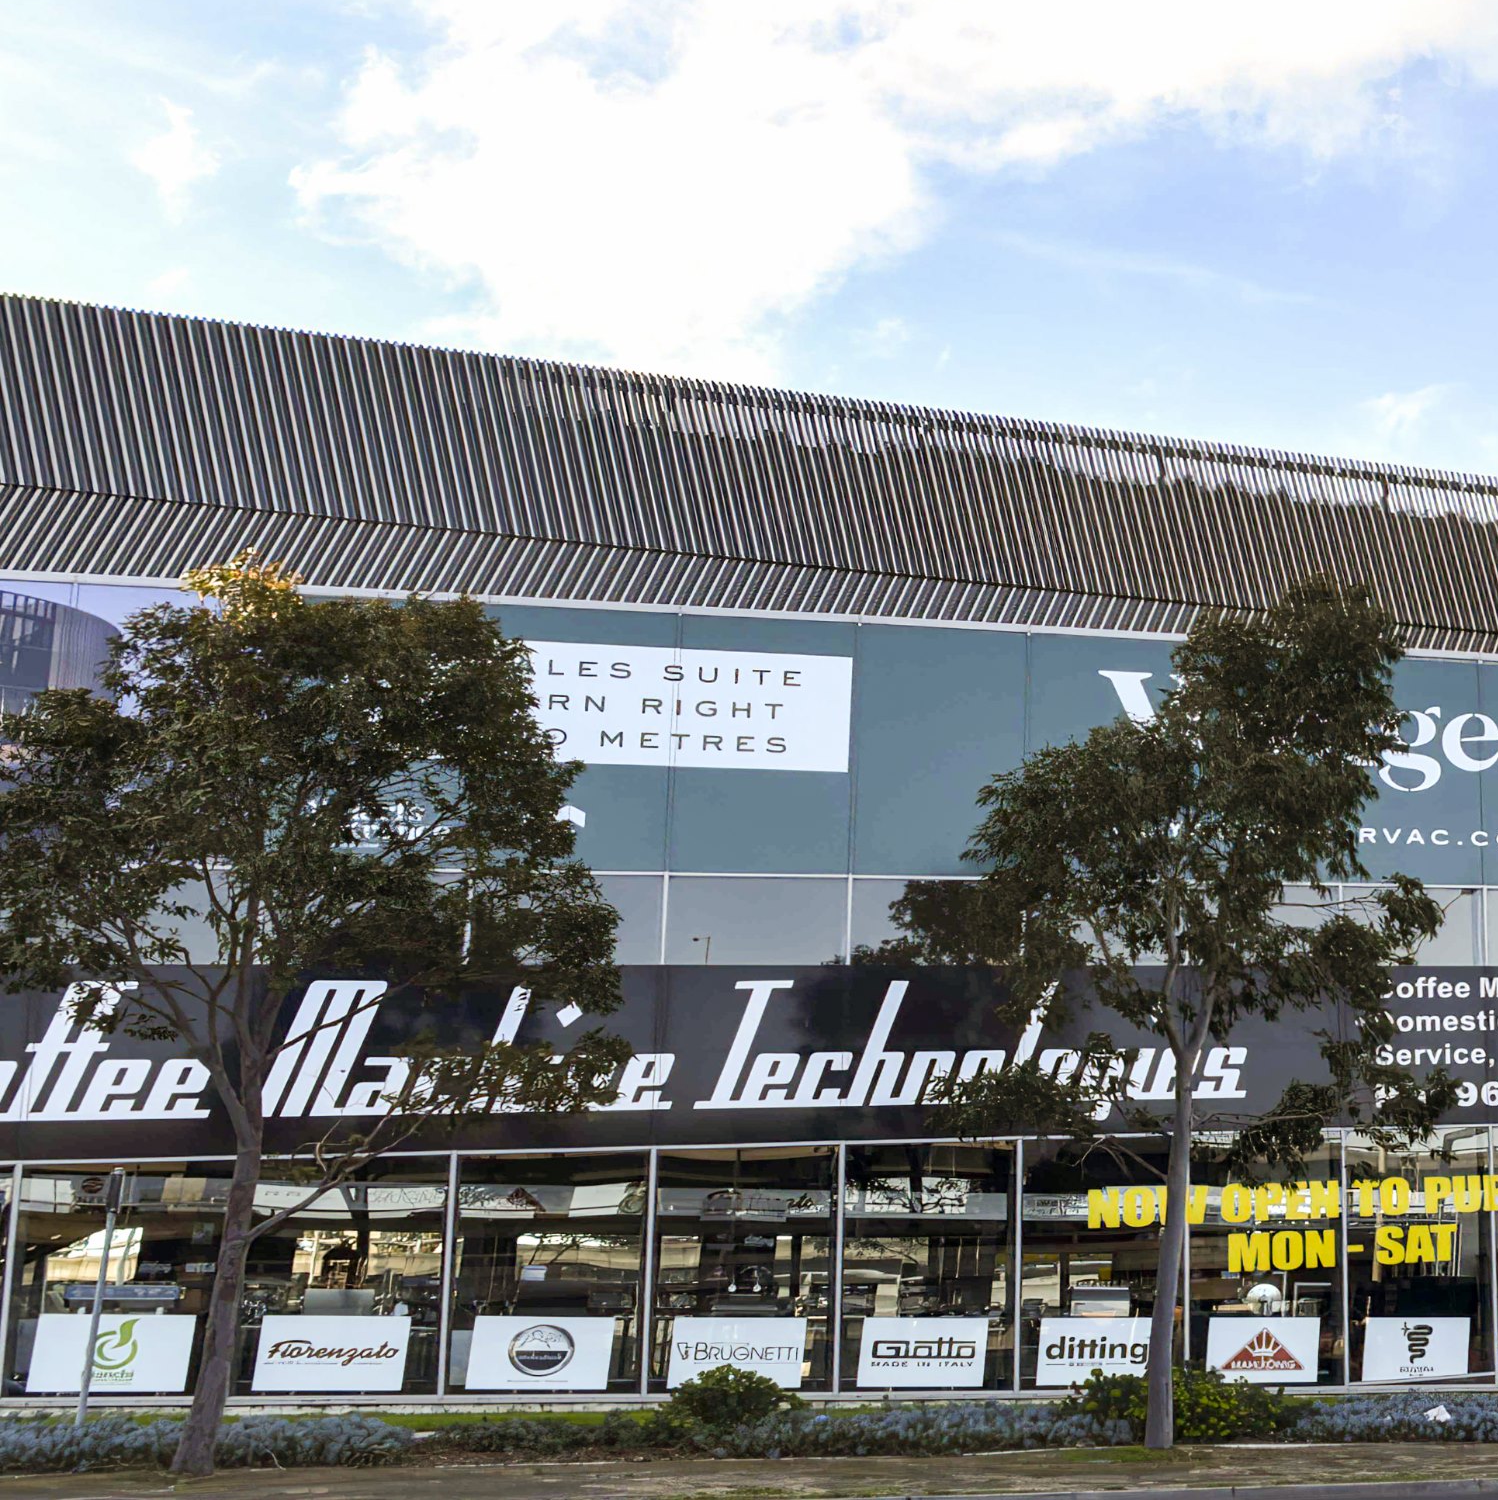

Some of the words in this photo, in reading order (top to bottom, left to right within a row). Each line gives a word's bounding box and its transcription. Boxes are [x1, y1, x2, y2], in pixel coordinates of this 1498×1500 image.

[530, 659, 632, 679] LES
[663, 664, 801, 687] SUITE
[547, 693, 606, 713] RN
[641, 698, 784, 720] RIGHT
[600, 730, 787, 754] METRES
[1375, 1043, 1496, 1068] Service,
[1087, 1185, 1209, 1229] NOW
[1221, 1179, 1340, 1224] OPEN
[1352, 1176, 1411, 1218] TO
[1227, 1229, 1336, 1273] MON
[1376, 1223, 1458, 1266] SAT
[267, 1339, 400, 1366] Fiorenzato
[693, 1342, 799, 1361] BRUGNETTI
[1045, 1336, 1149, 1366] ditting
